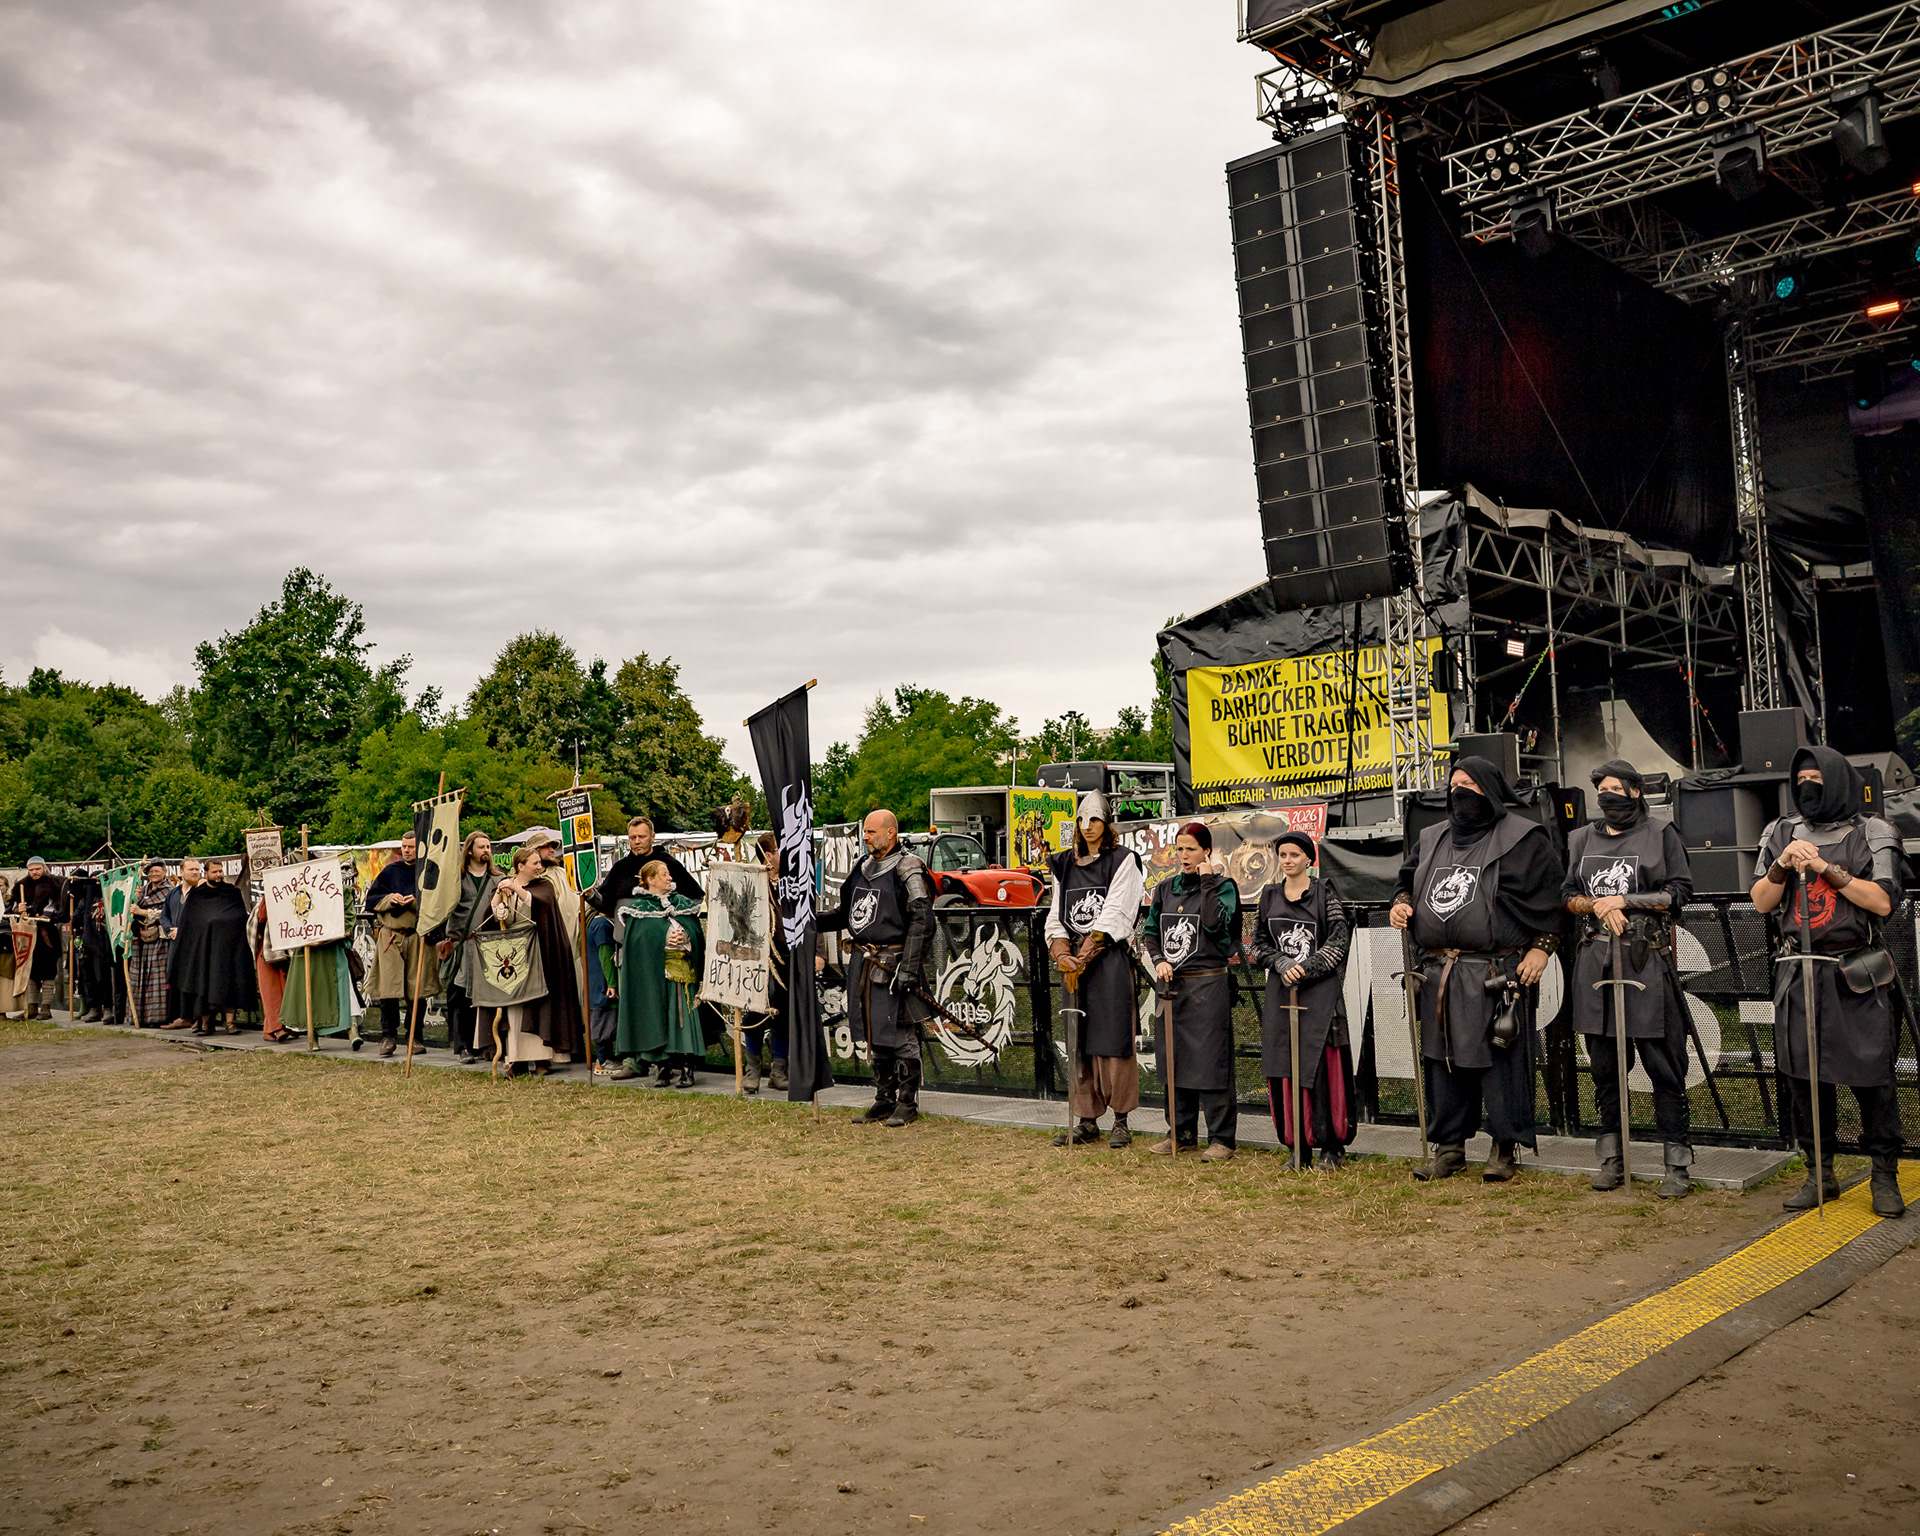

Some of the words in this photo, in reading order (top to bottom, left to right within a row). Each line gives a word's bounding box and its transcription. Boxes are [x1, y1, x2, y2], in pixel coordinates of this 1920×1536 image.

[1221, 663, 1288, 694] BÄNKE,
[1211, 685, 1312, 722] BARHOCKER
[1228, 716, 1286, 747] BÜHNE
[1292, 809, 1317, 823] 2026
